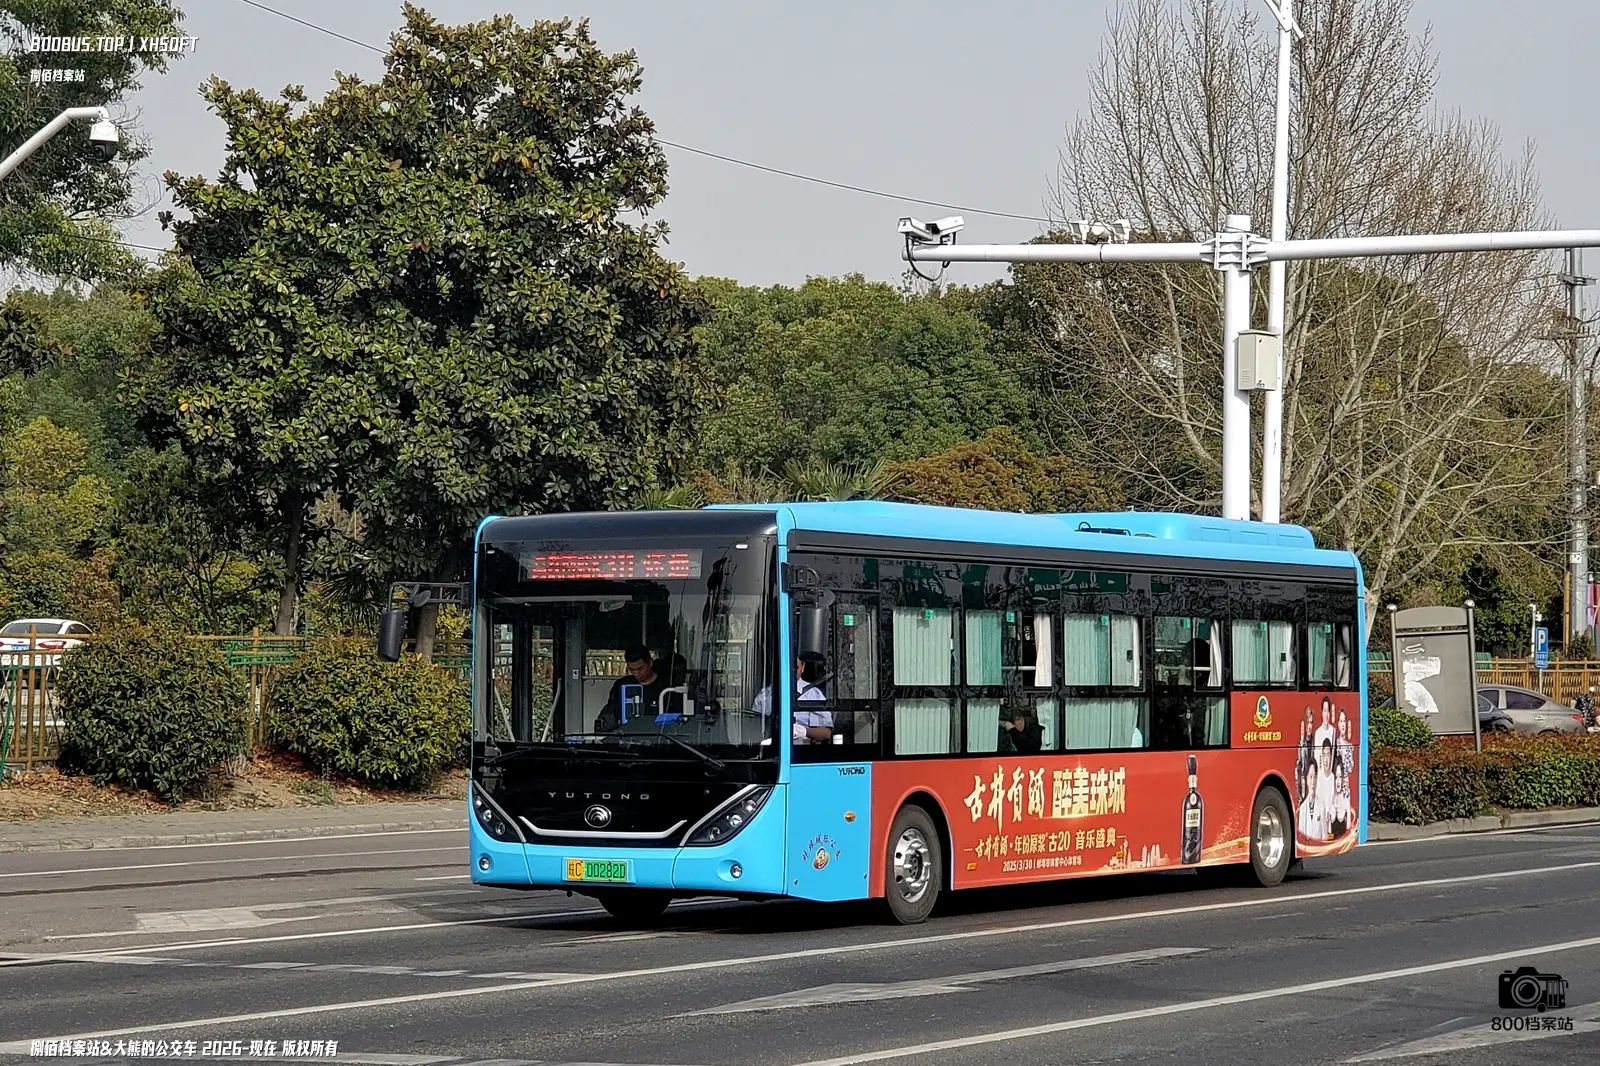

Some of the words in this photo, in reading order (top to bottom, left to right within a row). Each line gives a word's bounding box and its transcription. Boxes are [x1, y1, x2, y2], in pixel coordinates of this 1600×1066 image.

[1538, 629, 1546, 651] P
[837, 767, 866, 776] YUTONG
[548, 791, 650, 800] YUTONG
[1052, 764, 1126, 818] 醉美珠城
[1075, 827, 1117, 851] 音乐盛典
[1002, 858, 1033, 872] 2025/3/30
